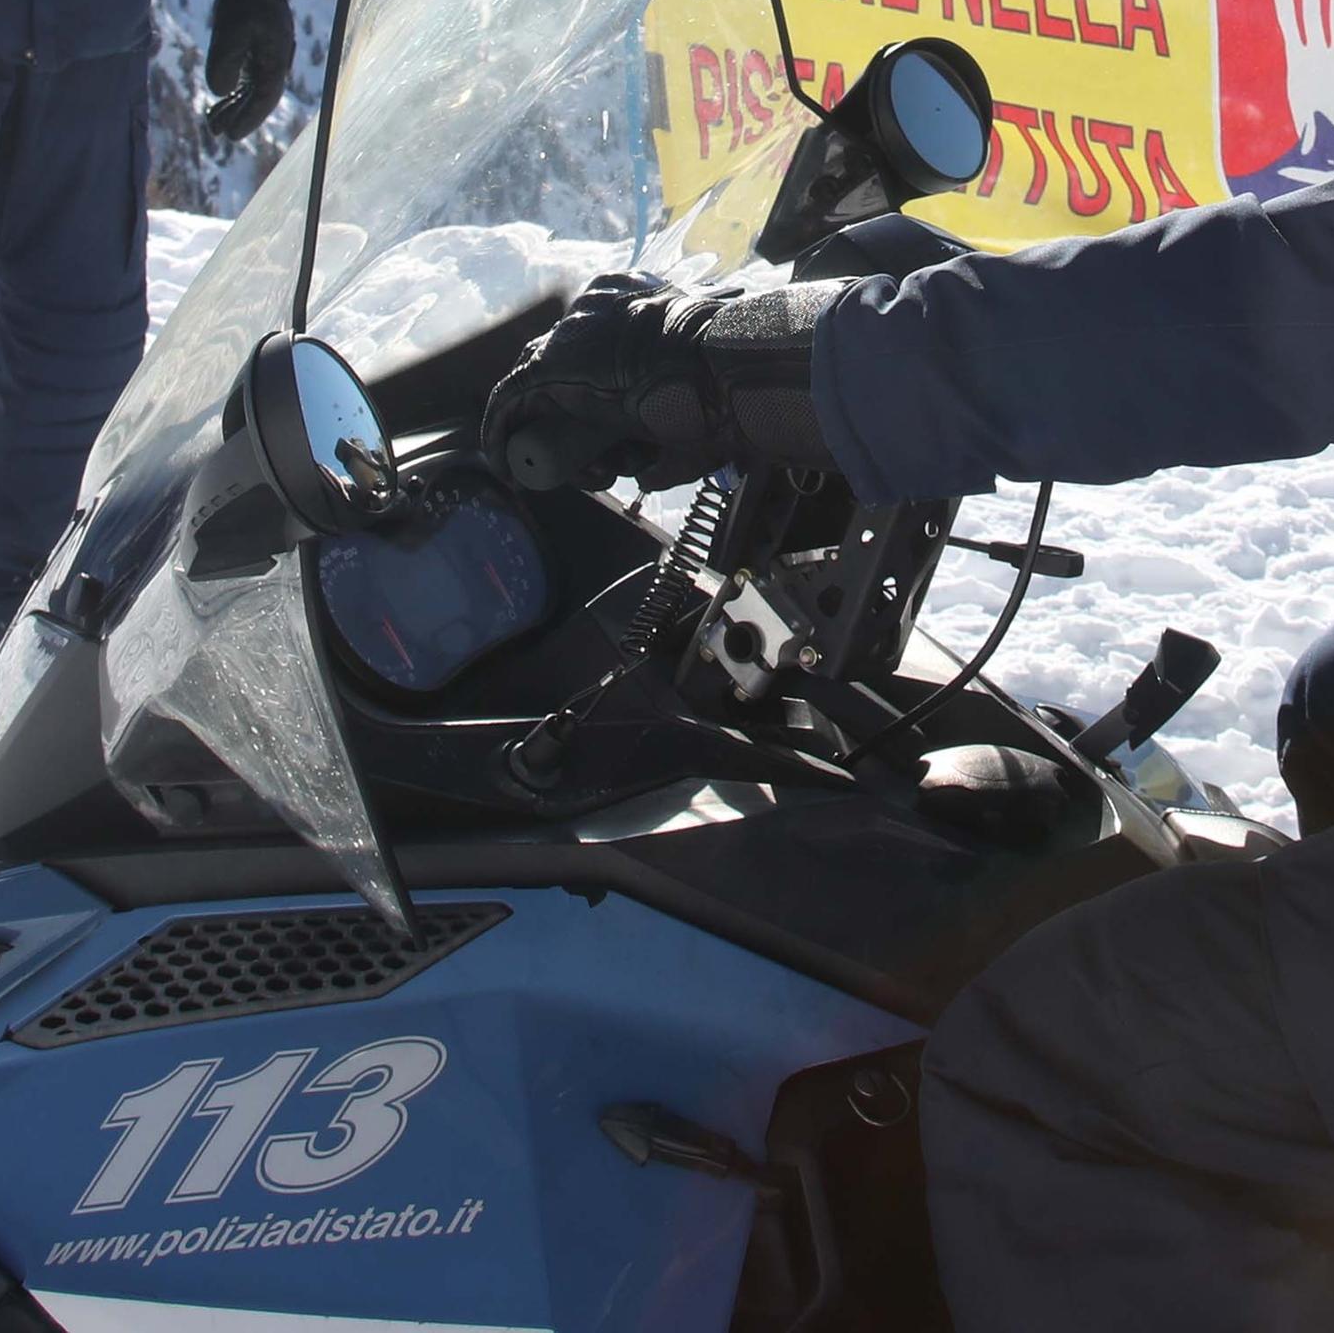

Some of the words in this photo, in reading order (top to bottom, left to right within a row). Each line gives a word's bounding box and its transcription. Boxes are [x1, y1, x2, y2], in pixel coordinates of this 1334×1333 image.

[951, 99, 1200, 224] TTUTA
[70, 1035, 448, 1216] 113
[43, 1198, 485, 1267] www.poliziadistato.it
